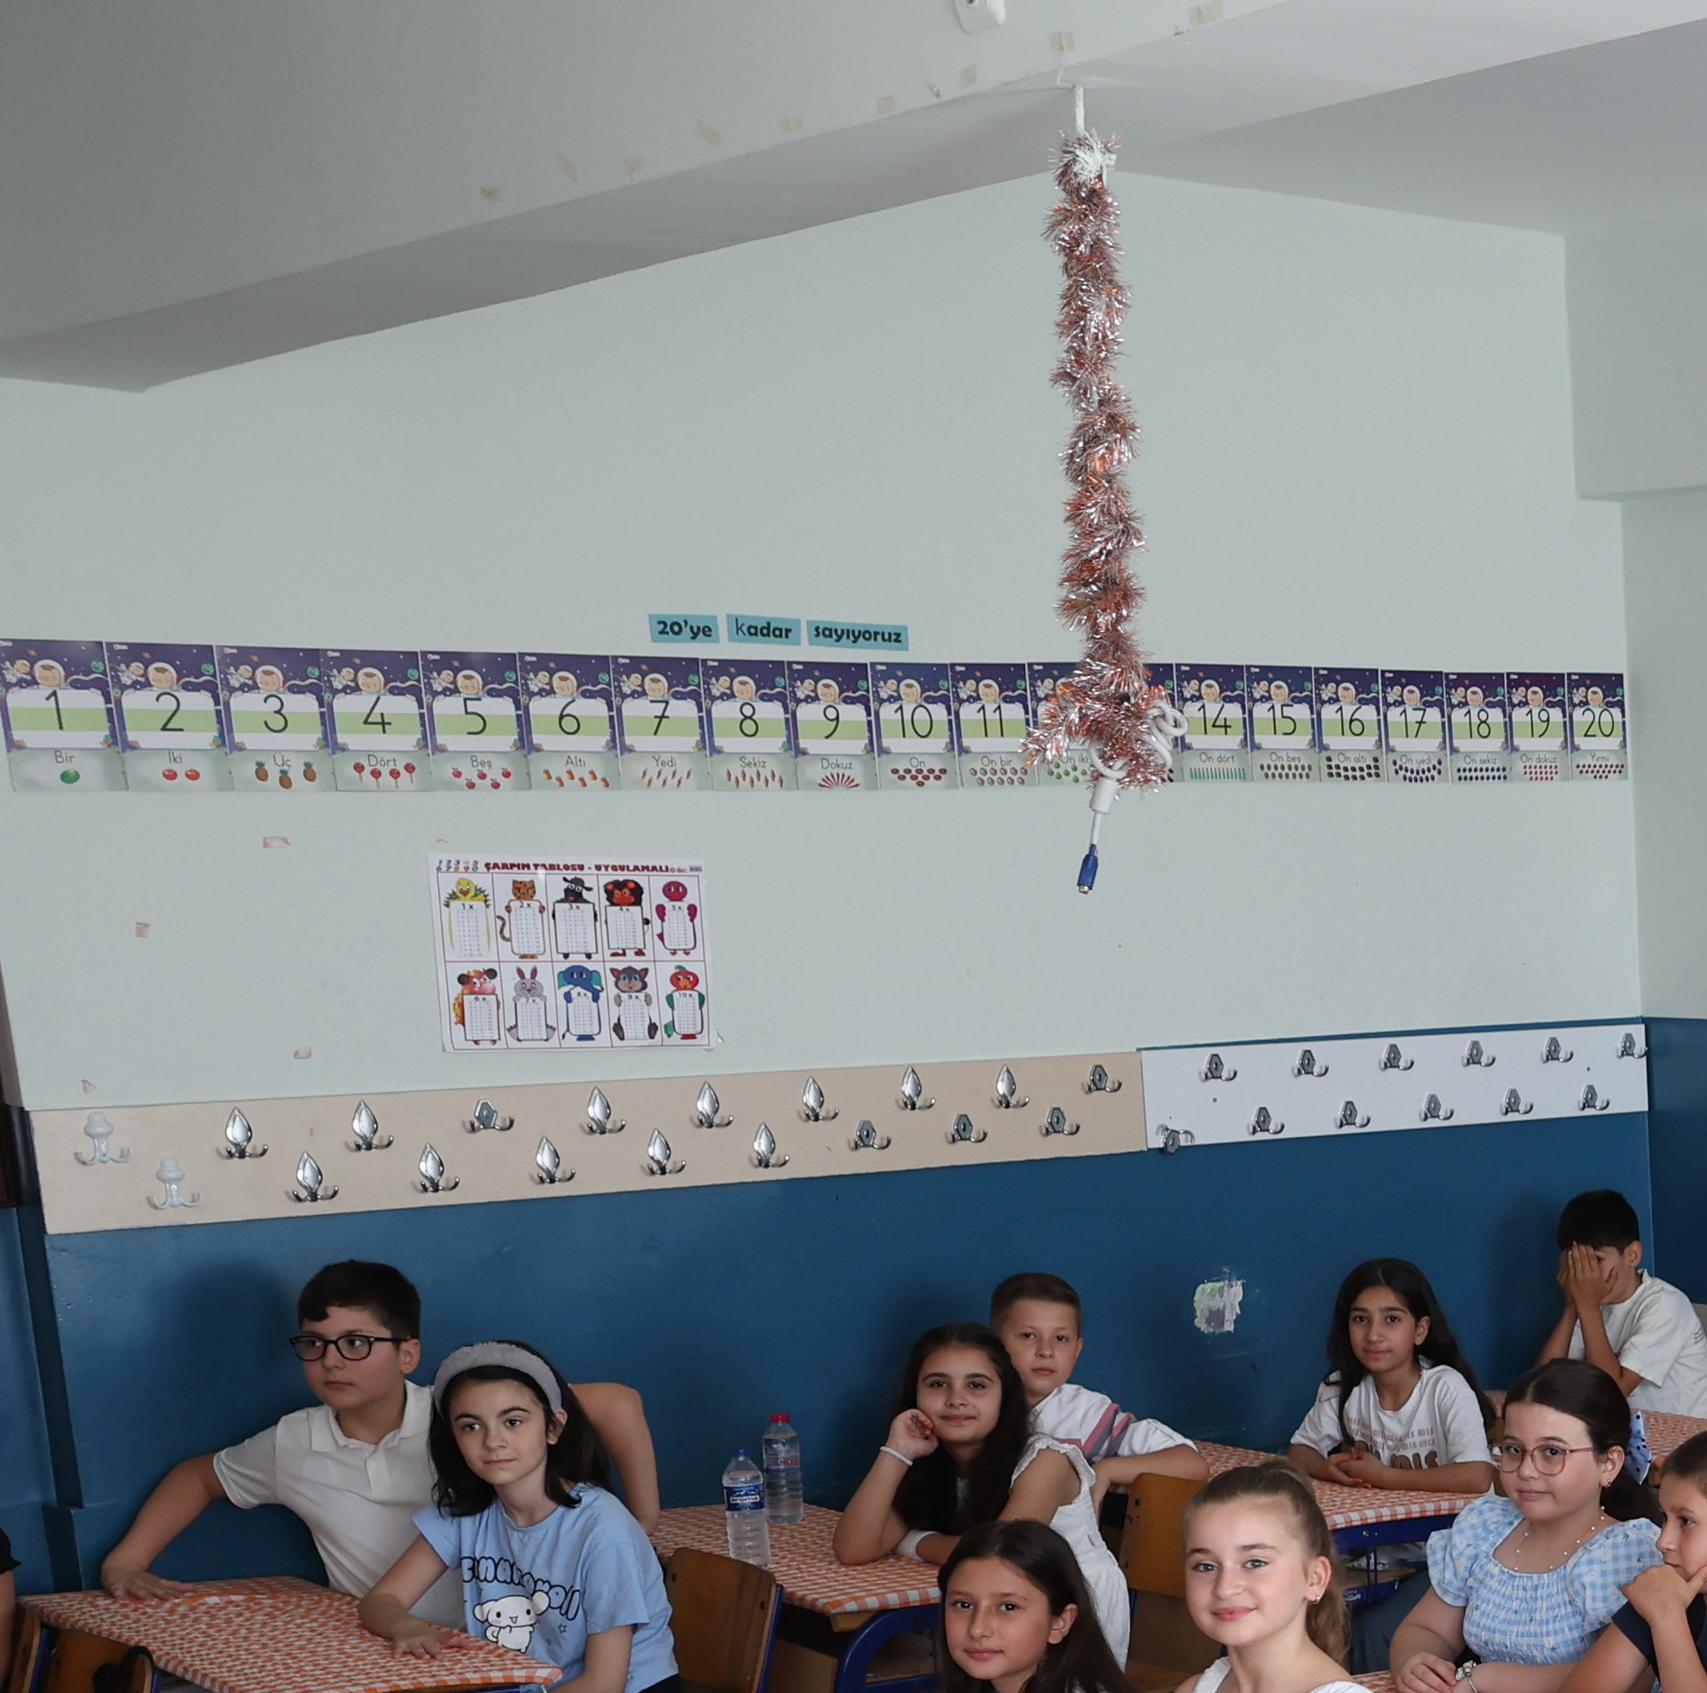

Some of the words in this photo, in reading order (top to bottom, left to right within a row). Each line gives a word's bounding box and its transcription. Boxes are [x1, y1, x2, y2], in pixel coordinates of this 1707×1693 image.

[657, 619, 713, 641] 20'ye
[735, 616, 793, 640] kadar
[814, 624, 902, 644] sayıyoruz
[45, 689, 64, 731] 1
[156, 692, 185, 732] 2
[263, 694, 289, 734] 3
[362, 694, 392, 735] 4
[463, 697, 487, 736] 5
[558, 698, 581, 736] 6
[649, 700, 670, 736] 7
[739, 702, 759, 738] 8
[823, 704, 840, 740] 9
[894, 704, 934, 739] 10
[976, 704, 1005, 738] 11
[1197, 703, 1232, 736] 14
[1267, 704, 1297, 736] 15
[1335, 704, 1365, 736] 16
[1399, 707, 1427, 739] 17
[1464, 708, 1491, 739] 18
[1526, 708, 1550, 738] 19
[1582, 708, 1615, 738] 20
[54, 751, 75, 764] Bir
[273, 751, 292, 769] Üç
[367, 754, 397, 768] Dört
[470, 755, 493, 770] Beş
[739, 756, 767, 769] Sekiz
[820, 757, 853, 770] Dokuz
[909, 757, 927, 769] On
[980, 755, 997, 768] On
[1199, 752, 1215, 763] On
[1269, 752, 1284, 763] On
[1337, 753, 1350, 764] On
[1463, 754, 1477, 765] On
[1520, 754, 1534, 764] On
[484, 862, 531, 873] ÇARPIM
[532, 863, 585, 872] TABLOSU
[594, 864, 669, 873] UYGULAMALI
